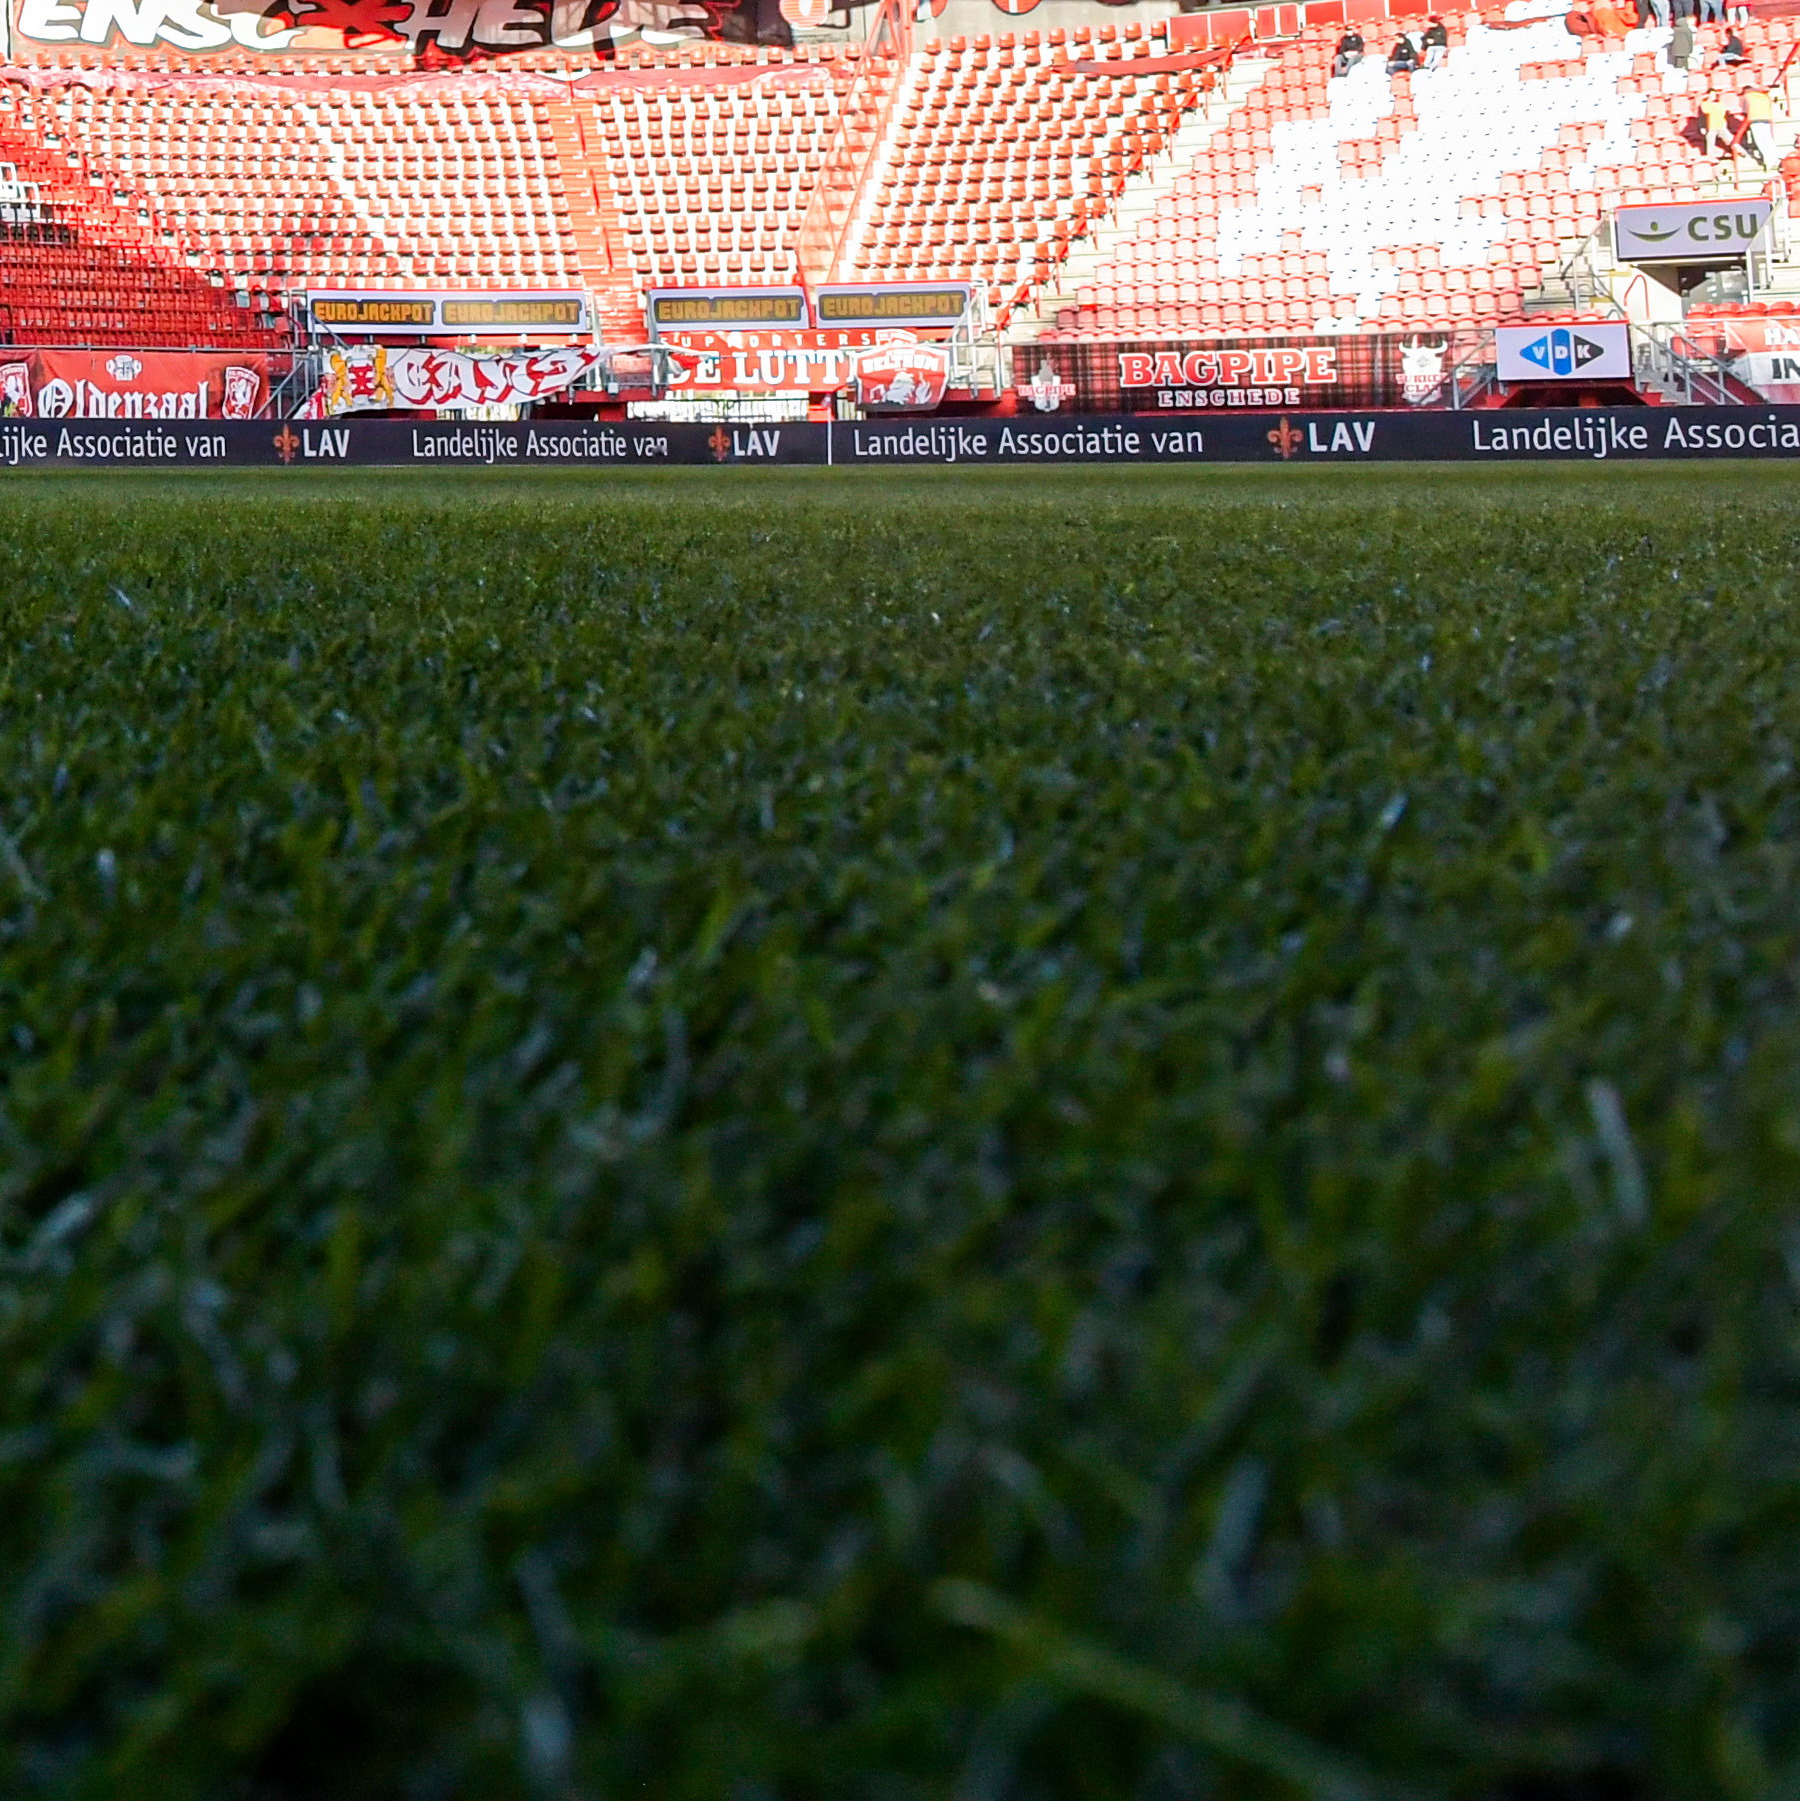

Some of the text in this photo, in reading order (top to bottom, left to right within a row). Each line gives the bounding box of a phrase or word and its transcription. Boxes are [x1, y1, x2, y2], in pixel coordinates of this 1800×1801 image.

[1687, 214, 1758, 241] CSU
[314, 301, 434, 322] EUROJACKPOT
[445, 301, 579, 323] EUROJACKPOT
[659, 299, 800, 321] EUROJACKPOT
[823, 293, 963, 317] EUROJACKPOT
[660, 331, 870, 348] SUPORTERS
[1532, 344, 1592, 360] VDK
[733, 348, 859, 385] LUTT
[1119, 347, 1337, 388] BAGPIPE
[38, 378, 209, 419] Oldenzaal
[1158, 387, 1301, 408] ENSCHEDE
[57, 427, 177, 458] Associatie
[185, 436, 226, 458] van
[303, 428, 668, 465] LAV Landelijke Associatie van
[733, 425, 1203, 462] LAV Landelijke Associatie van
[1308, 421, 1376, 453] LAV
[1473, 417, 1648, 459] Landelijke
